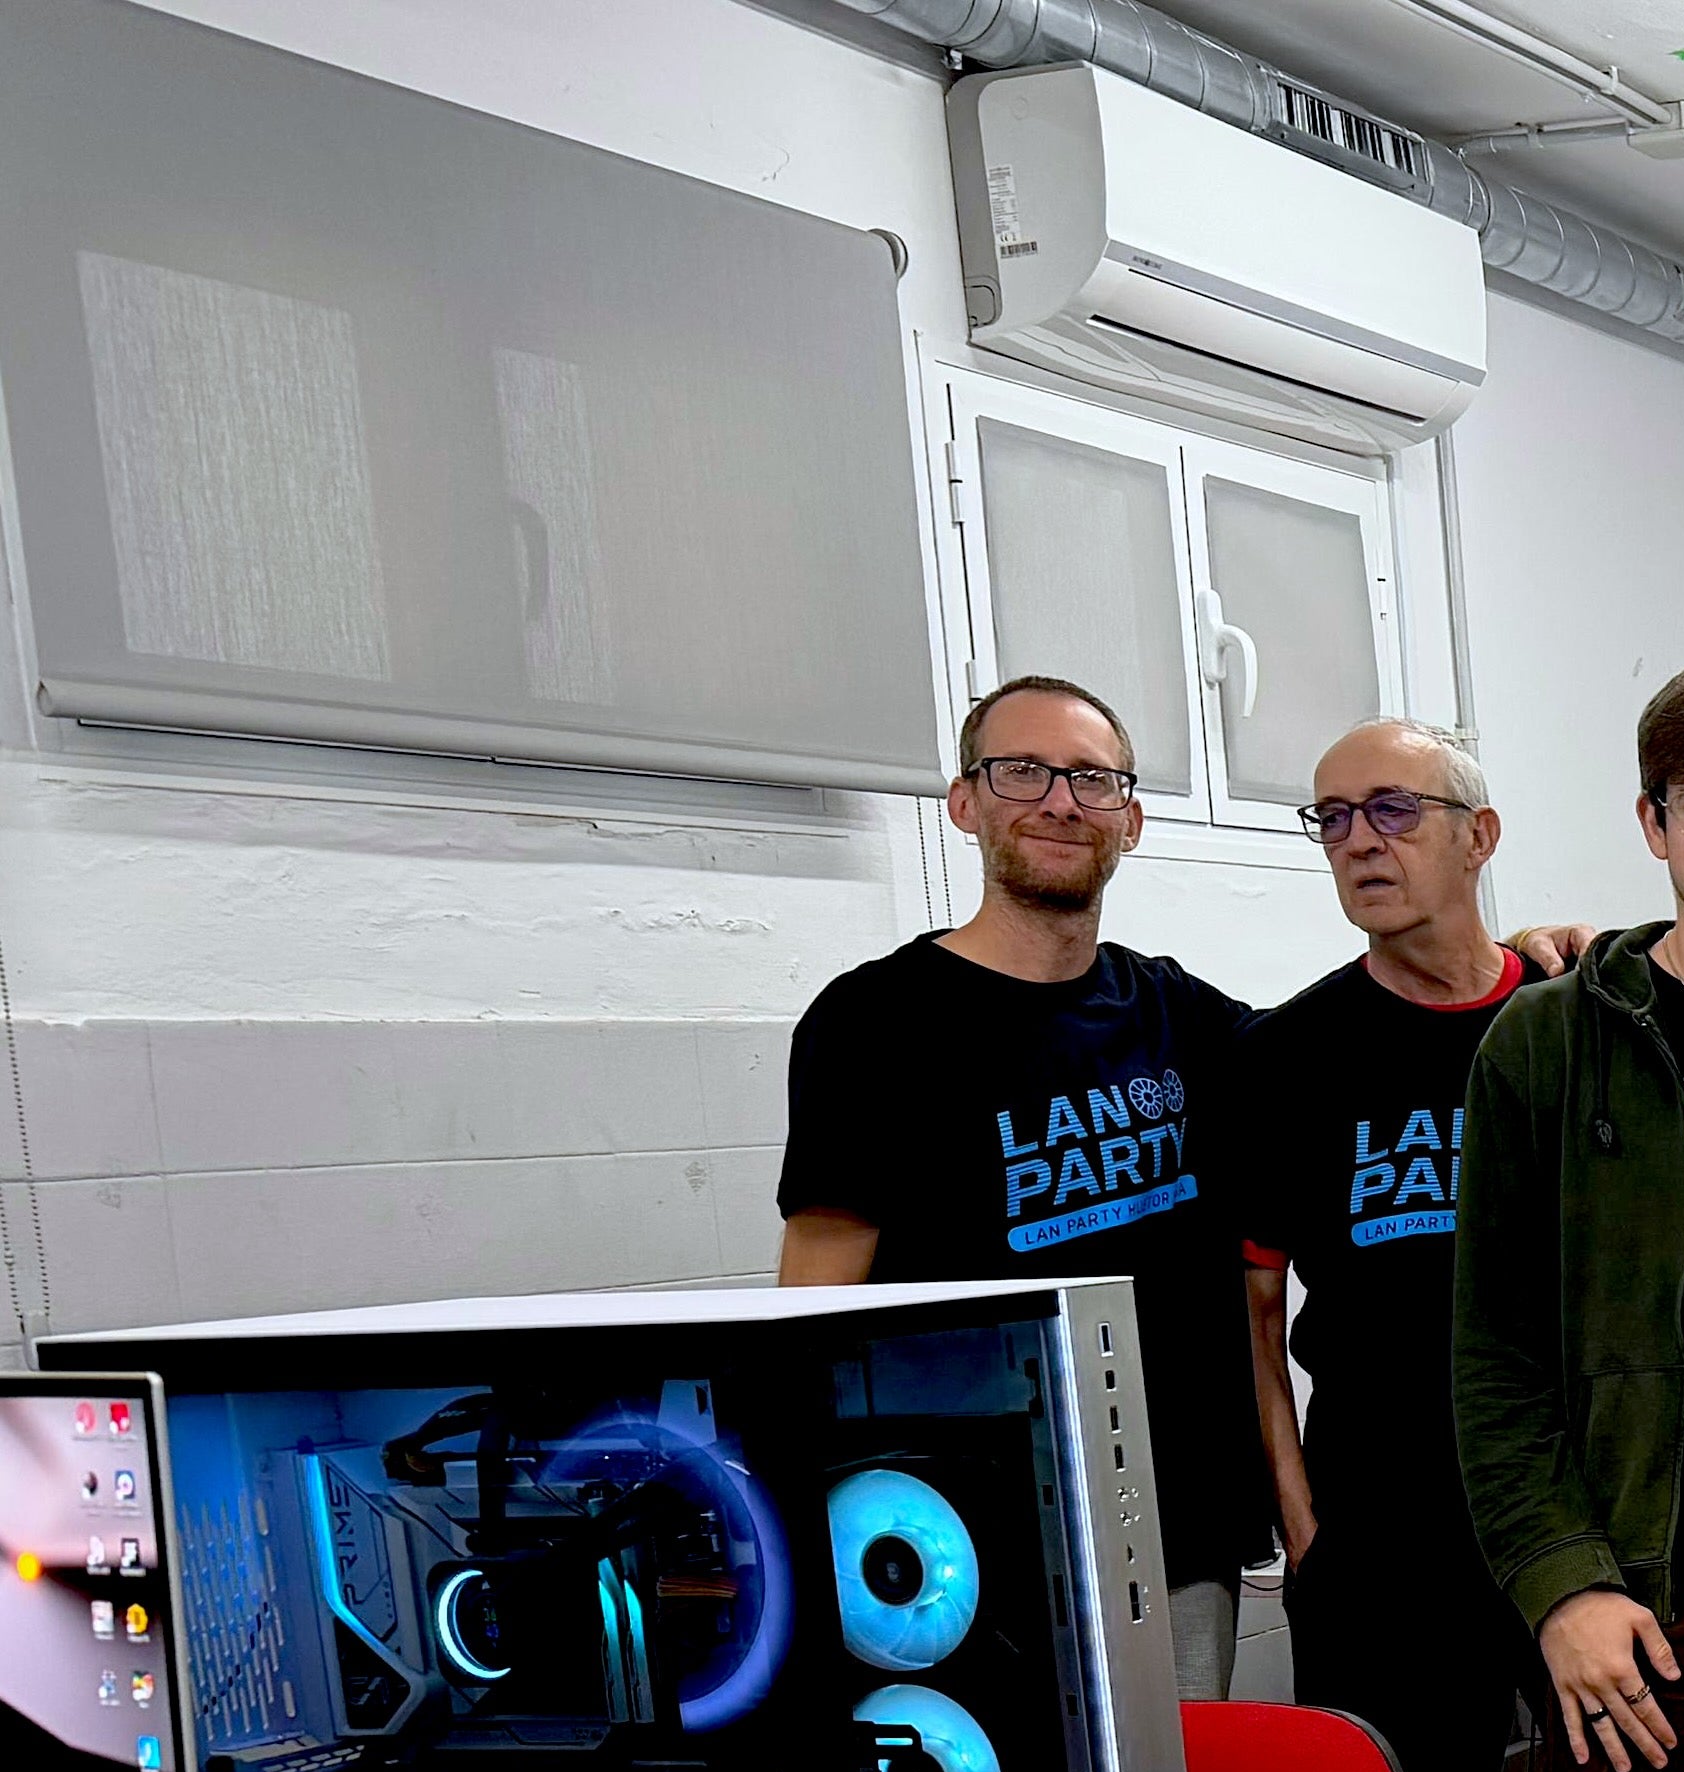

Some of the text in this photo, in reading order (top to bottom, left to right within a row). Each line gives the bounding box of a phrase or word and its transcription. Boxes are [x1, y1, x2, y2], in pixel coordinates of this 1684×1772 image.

[997, 1085, 1131, 1158] LAN
[1356, 1108, 1465, 1164] LA
[1006, 1117, 1187, 1217] PARTY
[1025, 1224, 1060, 1245] LAN
[1067, 1207, 1122, 1233] PARTY
[1365, 1221, 1397, 1240] LAN
